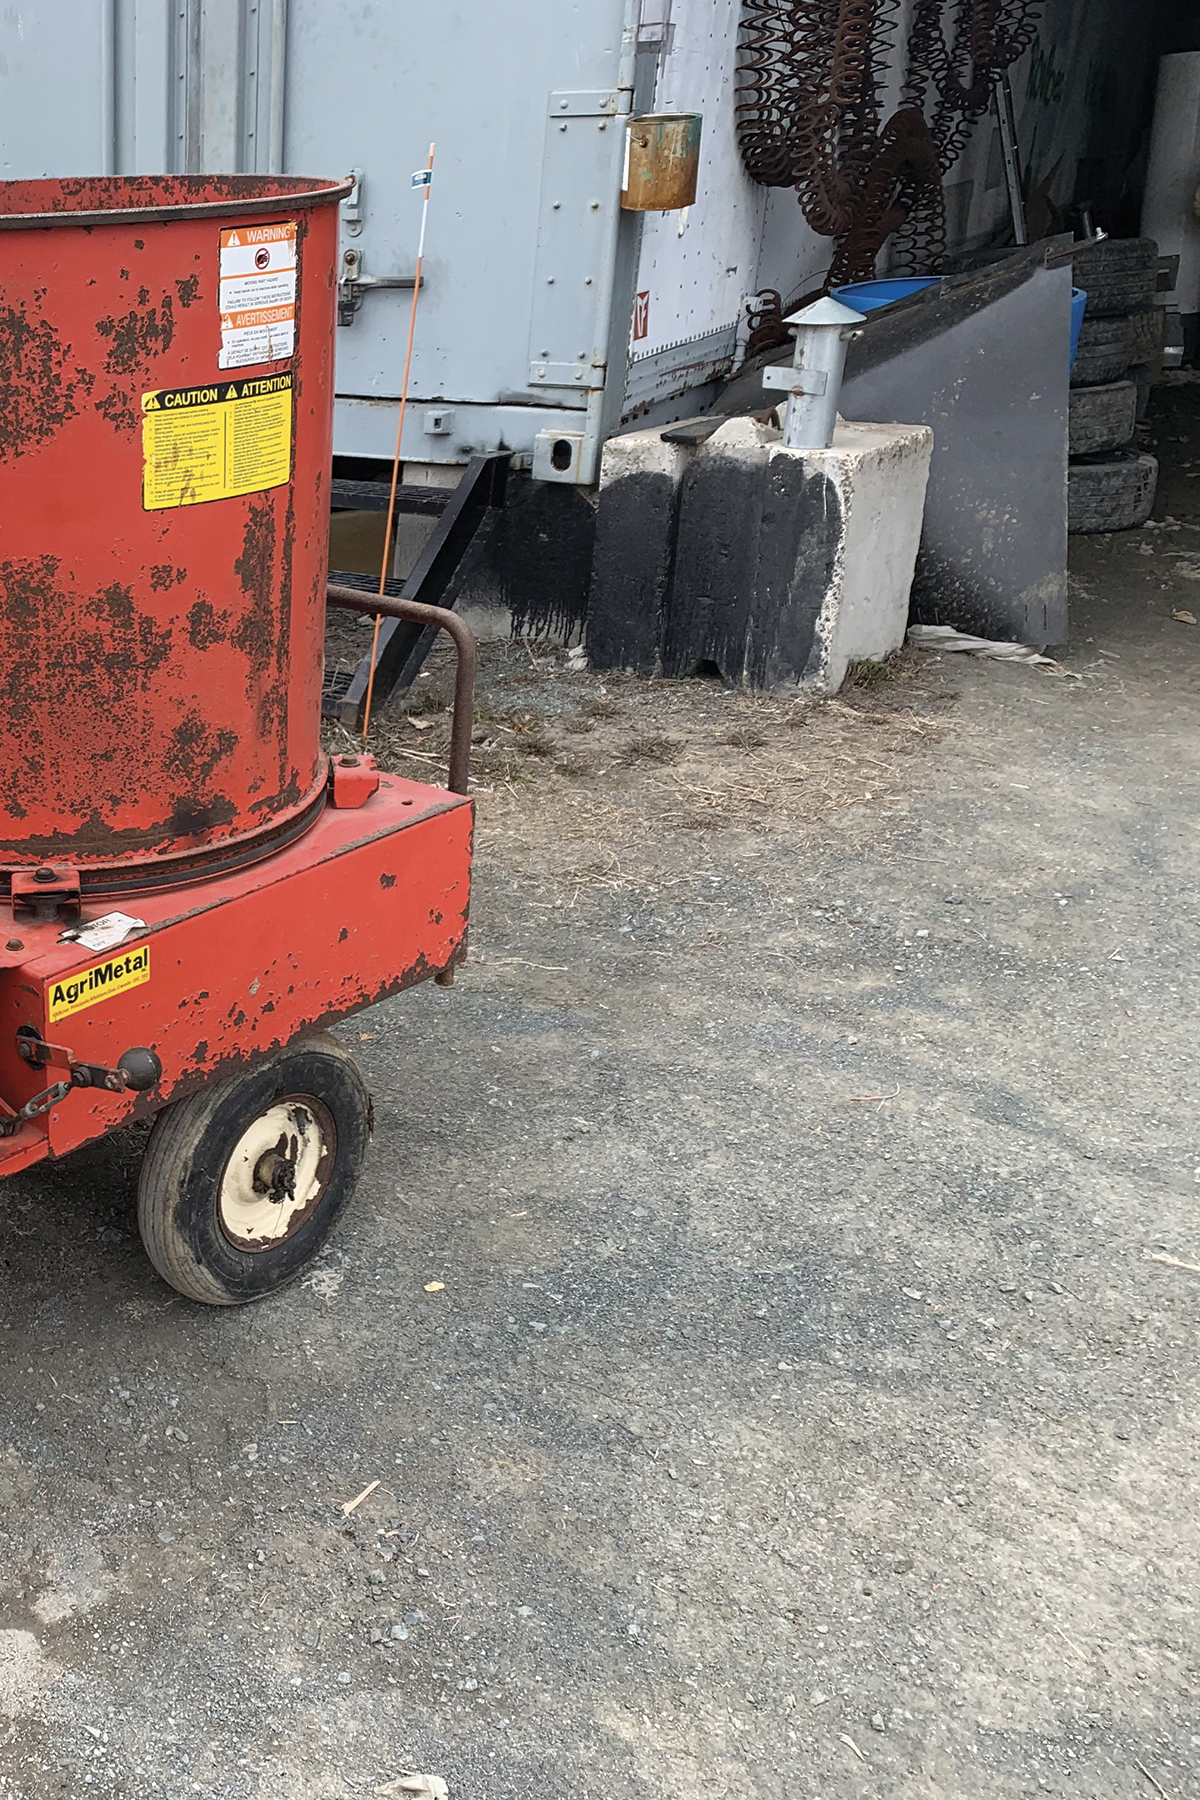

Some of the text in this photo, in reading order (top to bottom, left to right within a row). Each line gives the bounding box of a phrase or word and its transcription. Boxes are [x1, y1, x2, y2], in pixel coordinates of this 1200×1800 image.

[247, 226, 290, 243] WARNING
[236, 306, 293, 327] AVERTISSEMENT
[242, 375, 292, 397] ATTENTION
[164, 388, 218, 407] CAUTION
[52, 948, 148, 1007] AgriMetal
